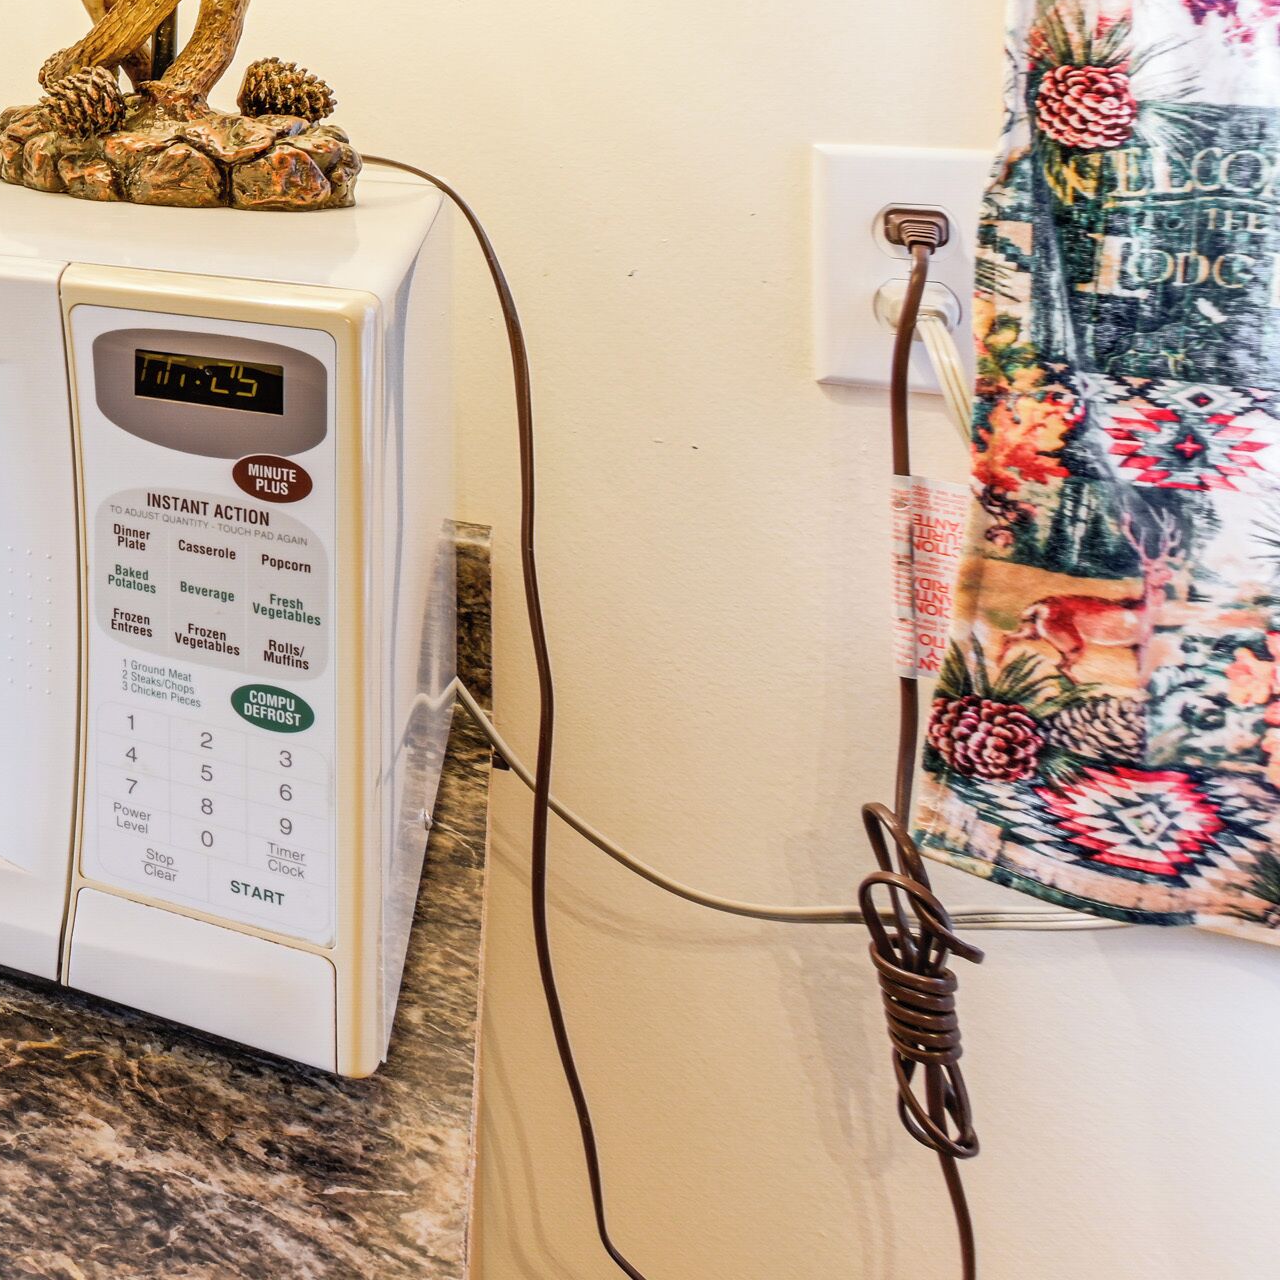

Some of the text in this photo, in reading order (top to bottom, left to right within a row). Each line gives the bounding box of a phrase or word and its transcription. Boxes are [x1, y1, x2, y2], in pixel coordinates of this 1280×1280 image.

[248, 463, 297, 483] MINUTE
[256, 479, 289, 496] PLUS
[147, 492, 270, 527] INSTANT ACTION
[110, 504, 123, 514] TO
[124, 507, 159, 520] ADJUST
[162, 514, 209, 529] QUANTITY
[218, 523, 252, 537] TOUCH
[255, 529, 274, 541] PAD
[277, 533, 308, 547] AGAIN
[113, 523, 151, 541] Dinner
[117, 536, 146, 551] Plate
[178, 539, 236, 560] Casserole
[115, 564, 149, 581] Baked
[261, 554, 311, 574] Popcorn
[108, 575, 156, 594] Potatoes
[180, 581, 235, 603] Beverage
[269, 593, 303, 610] Fresh
[113, 608, 150, 625] Frozen
[252, 602, 322, 626] Vegetables
[111, 619, 153, 638] Entrees
[187, 623, 226, 641] Frozen
[174, 632, 241, 656] Vegetables
[268, 639, 305, 657] Rolls/
[263, 650, 309, 670] Muffins
[130, 660, 166, 677] Ground
[168, 667, 192, 683] Meat
[131, 671, 195, 695] Steaks/Chops
[130, 682, 167, 701] Chicken
[170, 691, 202, 708] Pieces
[249, 690, 295, 712] COMPU
[127, 714, 135, 730] 1
[243, 702, 302, 727] DEFROST
[200, 731, 213, 749] 2
[125, 746, 138, 763] 4
[279, 750, 293, 768] 3
[201, 764, 213, 782] 5
[125, 778, 138, 795] 7
[279, 783, 293, 802] 6
[113, 802, 152, 822] Power
[201, 798, 213, 816] 8
[116, 815, 149, 834] Level
[279, 817, 293, 836] 9
[145, 848, 174, 866] Stop
[267, 841, 305, 862] Timer
[143, 863, 177, 883] Clear
[267, 859, 305, 879] Clock
[230, 880, 285, 906] START
